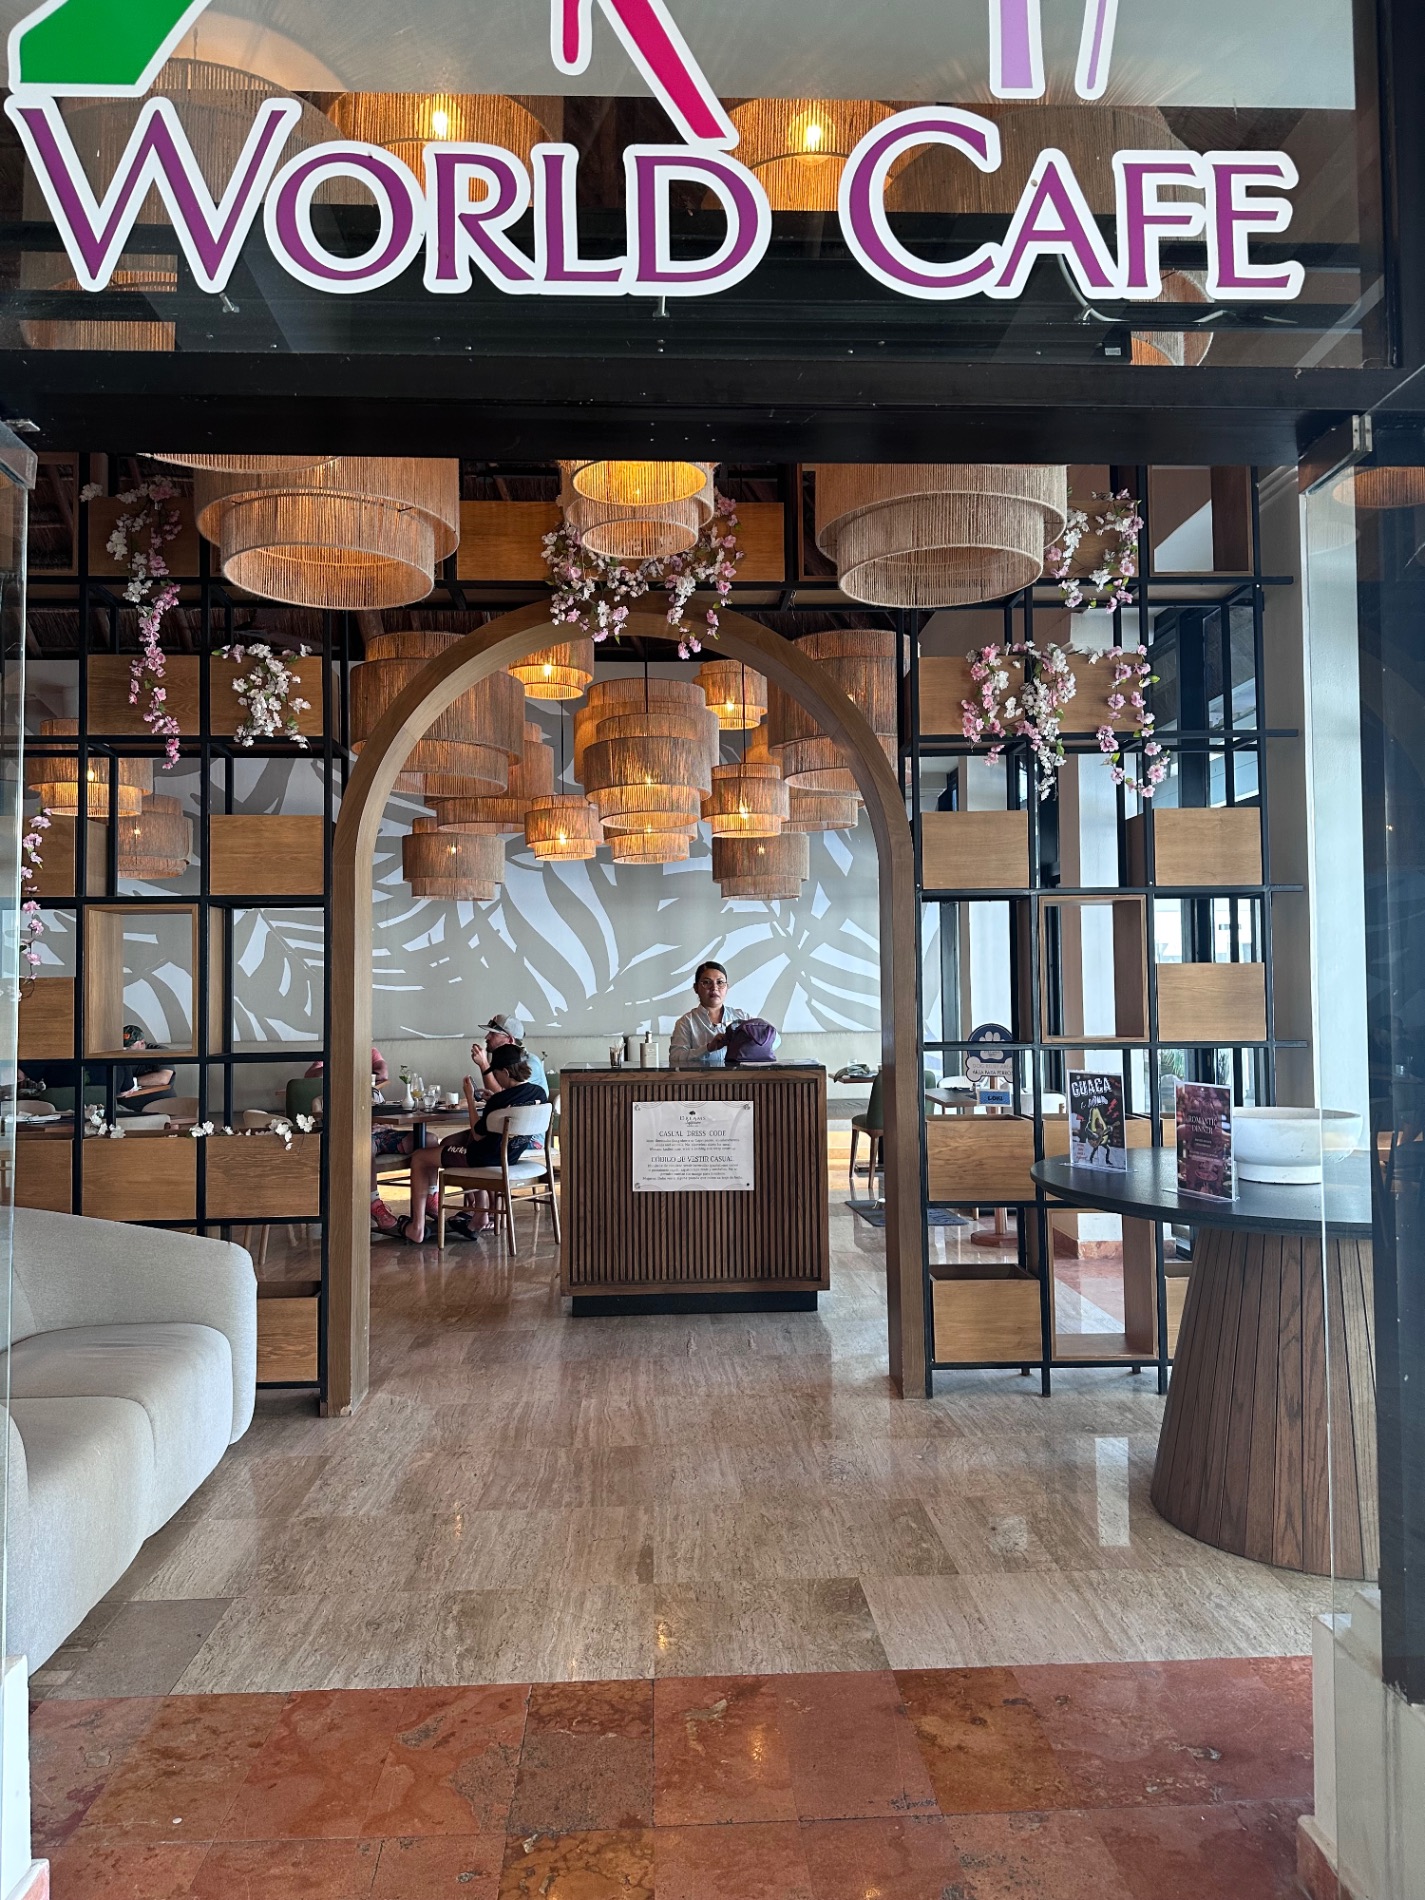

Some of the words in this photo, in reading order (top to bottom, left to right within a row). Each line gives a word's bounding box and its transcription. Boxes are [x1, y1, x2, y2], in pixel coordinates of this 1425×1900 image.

[5, 95, 771, 297] WORLD
[838, 106, 1305, 300] CAFE
[1071, 1076, 1113, 1098] GUACA
[1188, 1115, 1218, 1127] ROMANTIC
[1191, 1125, 1213, 1134] DINNER
[687, 1155, 710, 1163] VESTIR
